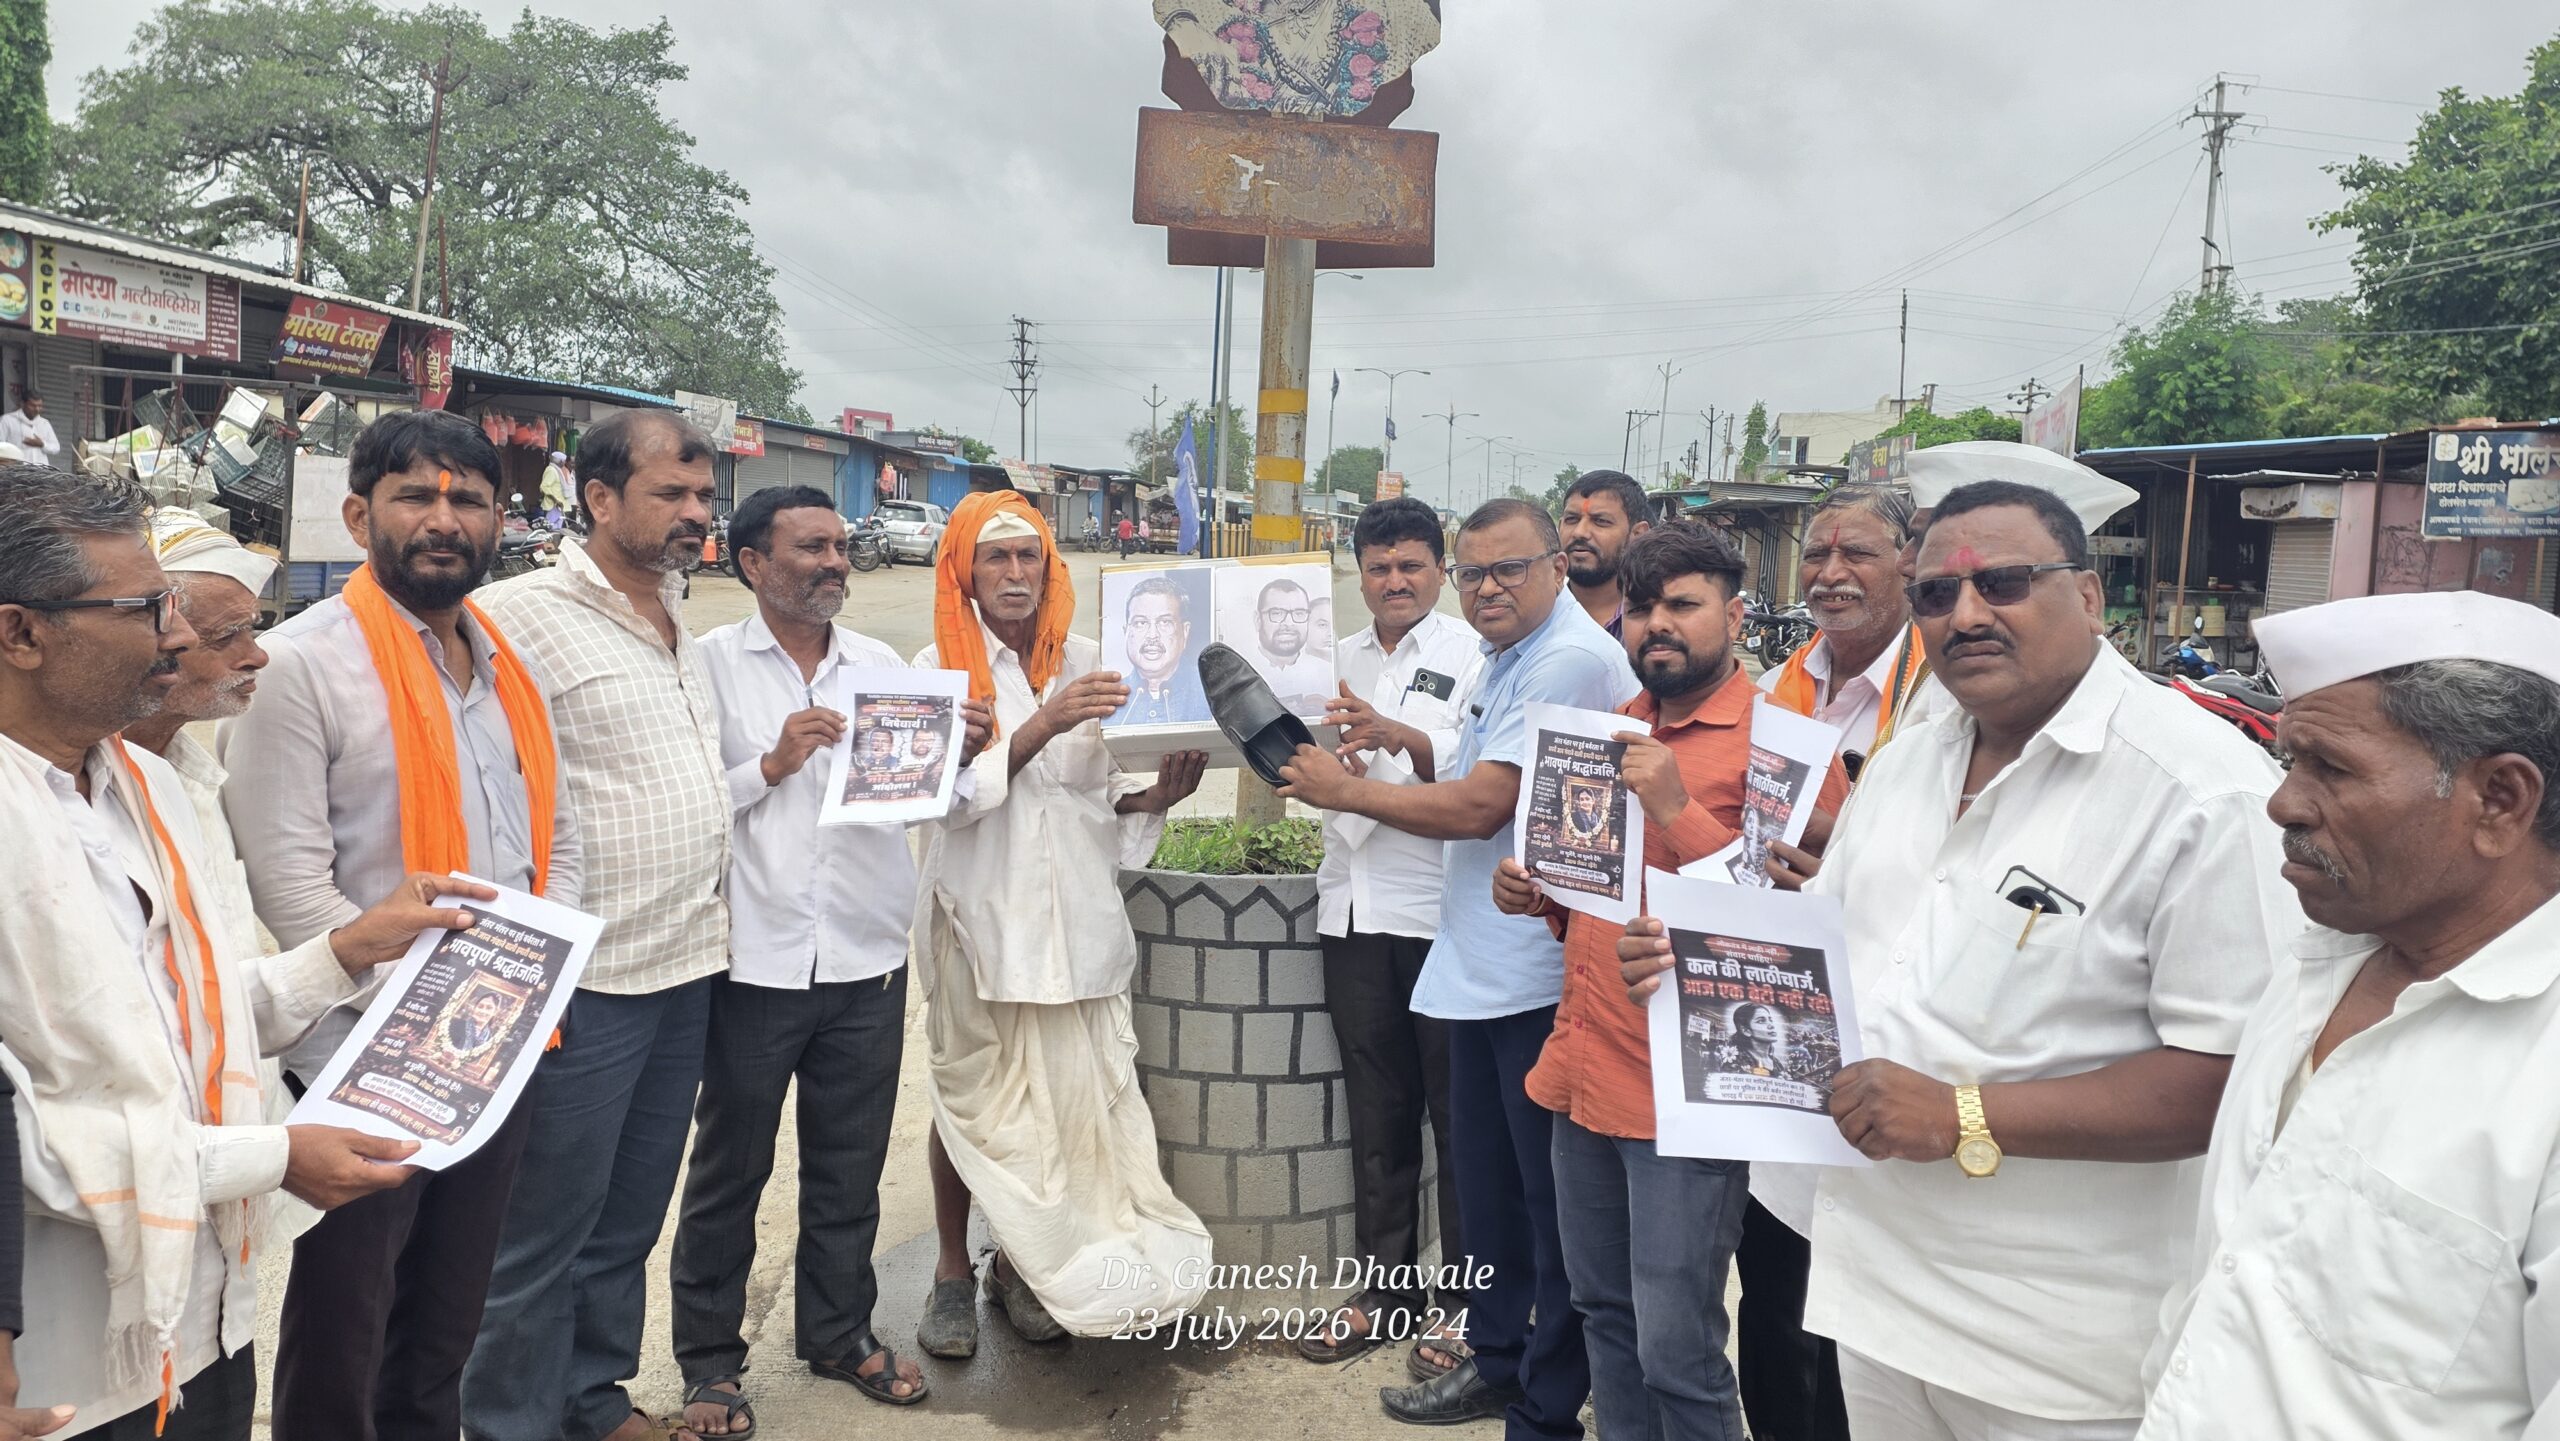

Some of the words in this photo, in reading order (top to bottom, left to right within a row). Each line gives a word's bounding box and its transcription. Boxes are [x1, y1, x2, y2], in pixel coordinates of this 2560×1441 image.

[59, 261, 118, 303] मोरया
[284, 306, 341, 342] मोरया
[339, 317, 386, 350] टेलर्स
[2457, 435, 2493, 476] श्री
[1544, 755, 1572, 775] भावपूर्ण
[1572, 760, 1616, 778] श्रद्धांजलि
[449, 938, 499, 968] भावपूर्ण
[493, 956, 545, 986] श्रद्धांजलि
[1685, 957, 1718, 976] कल
[1720, 958, 1742, 979] की
[1744, 964, 1820, 994] लाठीचार्ज,
[1683, 978, 1716, 998] आज
[1718, 981, 1745, 1001] एक
[1747, 981, 1775, 1005] बेटी
[1777, 988, 1806, 1010] नहीं
